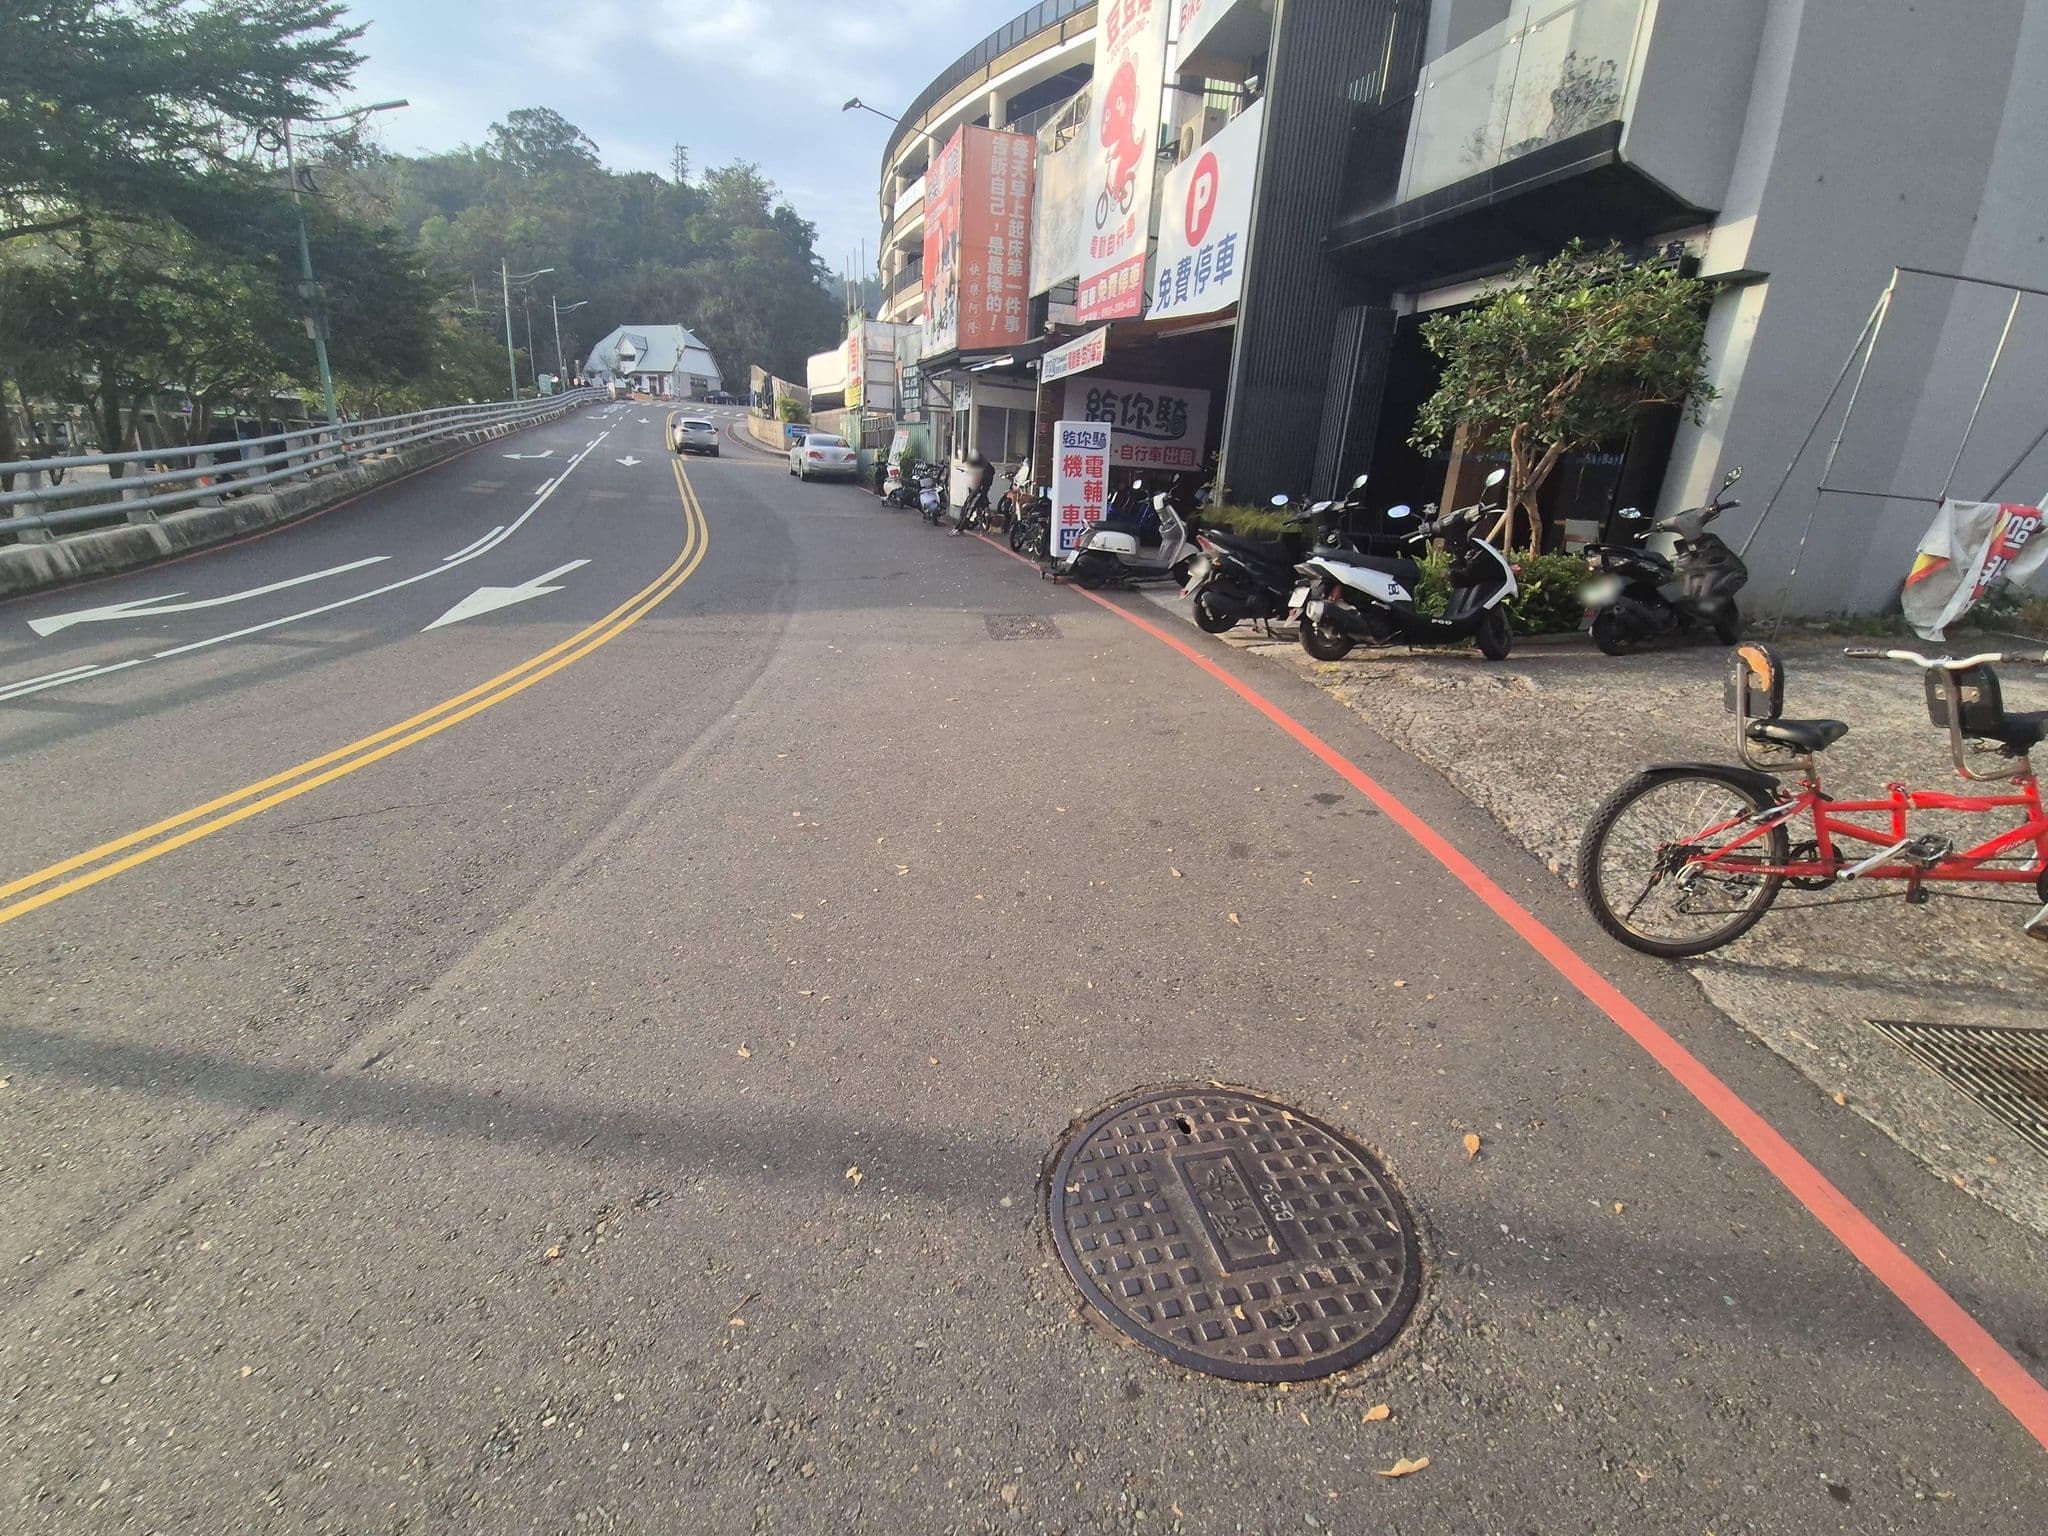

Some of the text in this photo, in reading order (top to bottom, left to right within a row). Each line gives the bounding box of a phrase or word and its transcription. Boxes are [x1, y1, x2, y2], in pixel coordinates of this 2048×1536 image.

[1191, 169, 1211, 232] P
[1097, 263, 1141, 303] 免費停車
[1156, 232, 1237, 312] 免費停車
[1086, 387, 1188, 436] 給你騎
[1063, 430, 1106, 449] 給你騎
